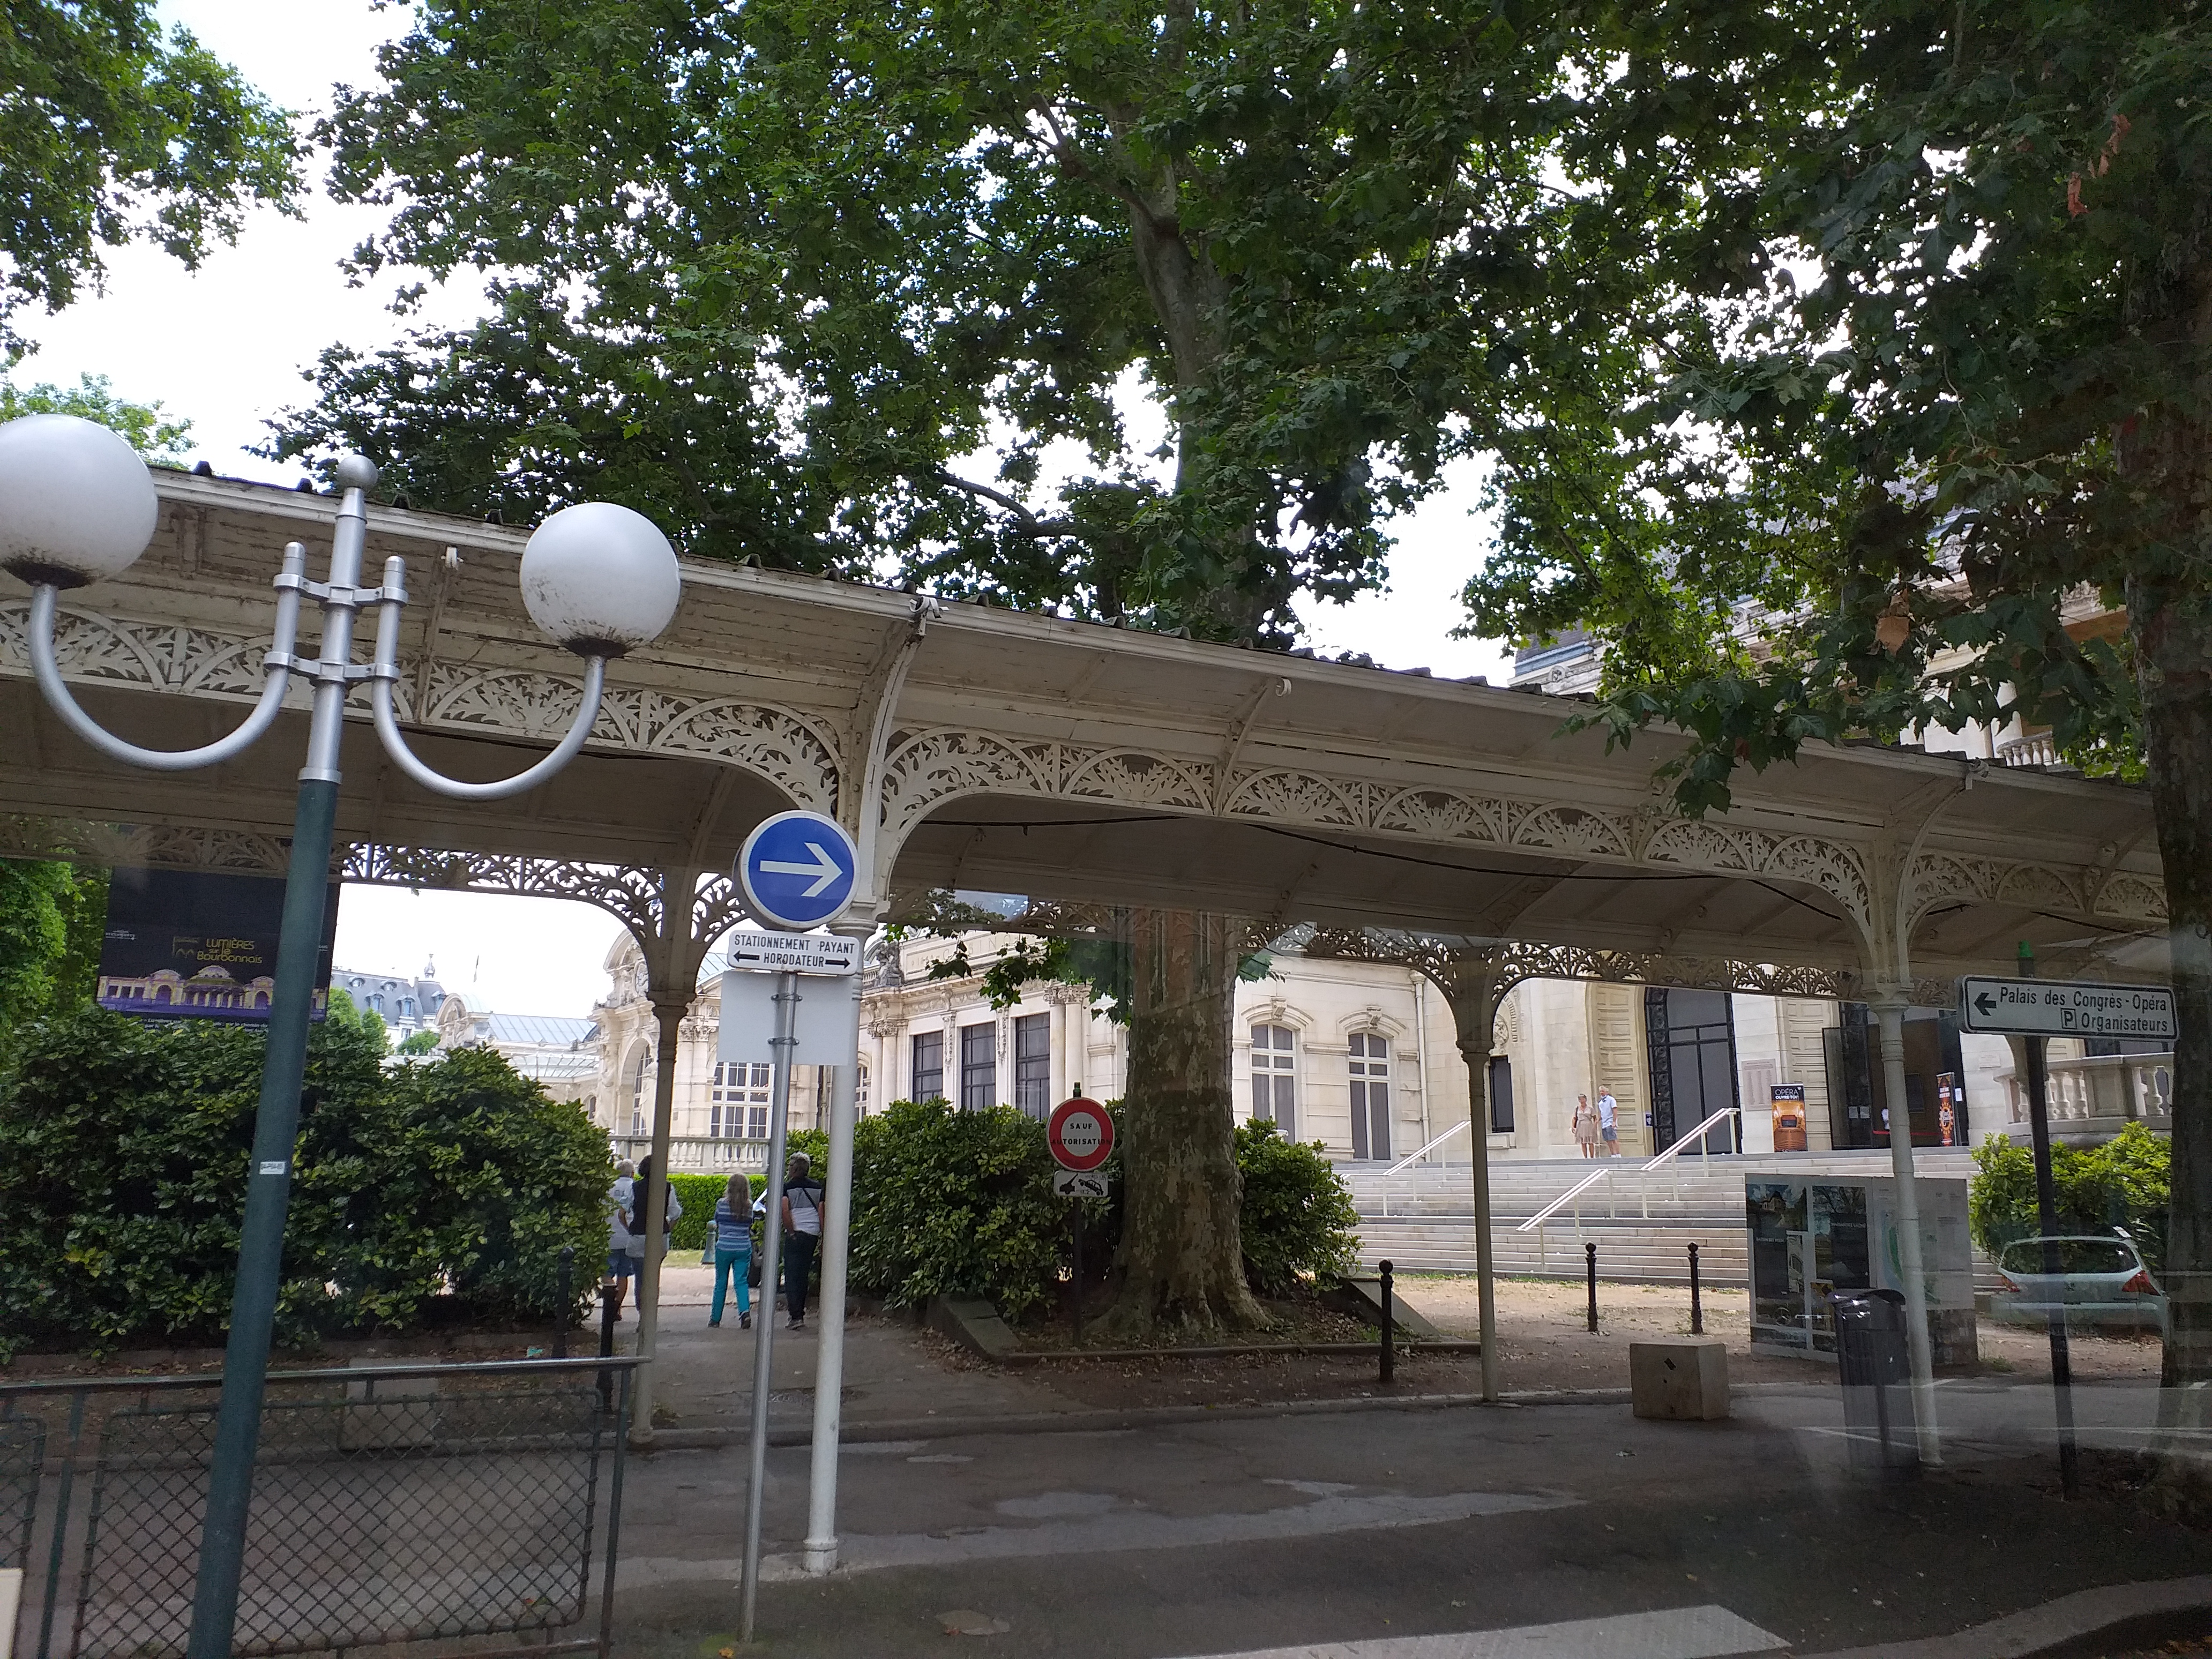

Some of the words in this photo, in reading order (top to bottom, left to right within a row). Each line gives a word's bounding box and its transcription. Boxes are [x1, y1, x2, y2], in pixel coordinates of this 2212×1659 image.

[206, 937, 256, 950] LUMIÈRES
[734, 934, 811, 951] STATIONNEMENT
[819, 941, 855, 954] PAYANT
[943, 933, 1011, 961] CSINO
[196, 951, 263, 964] Bourbonnais
[763, 952, 824, 968] HORODATEUR
[2000, 987, 2037, 1004] Palais
[2044, 989, 2066, 1005] des
[2073, 991, 2122, 1012] Congrès
[2132, 994, 2166, 1014] Opéra
[2064, 1010, 2073, 1027] P
[2081, 1012, 2168, 1032] Organisateurs
[1775, 1088, 1799, 1096] OPÉRA
